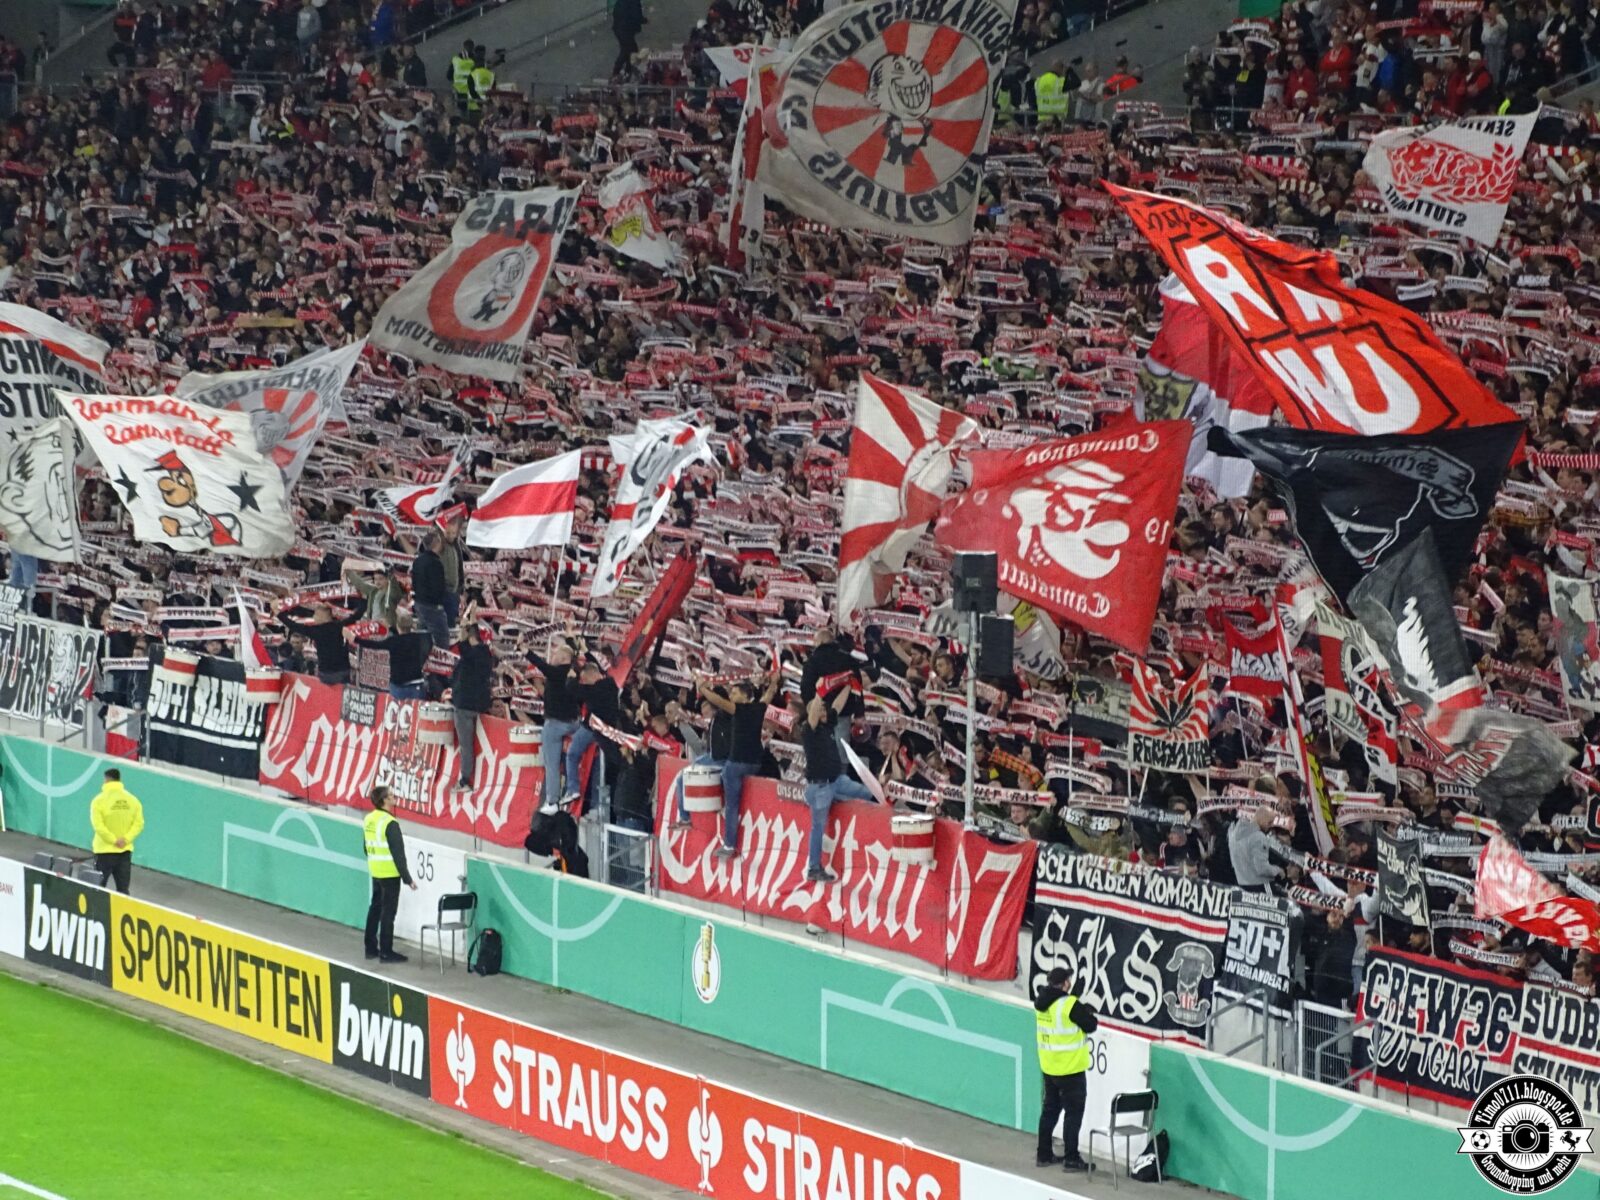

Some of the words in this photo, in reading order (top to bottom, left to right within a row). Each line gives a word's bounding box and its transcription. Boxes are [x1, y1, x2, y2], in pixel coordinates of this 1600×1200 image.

[167, 608, 218, 617] STUTTGART
[416, 851, 434, 882] 35
[946, 838, 1023, 967] 97
[1037, 851, 1142, 898] SCHWABEN
[1145, 870, 1231, 918] KOMPANIE
[29, 883, 106, 971] bwin
[120, 913, 324, 1043] SPORTWETTEN
[1520, 985, 1600, 1053] SÜDB
[338, 982, 425, 1080] bwin
[492, 1038, 670, 1161] STRAUSS
